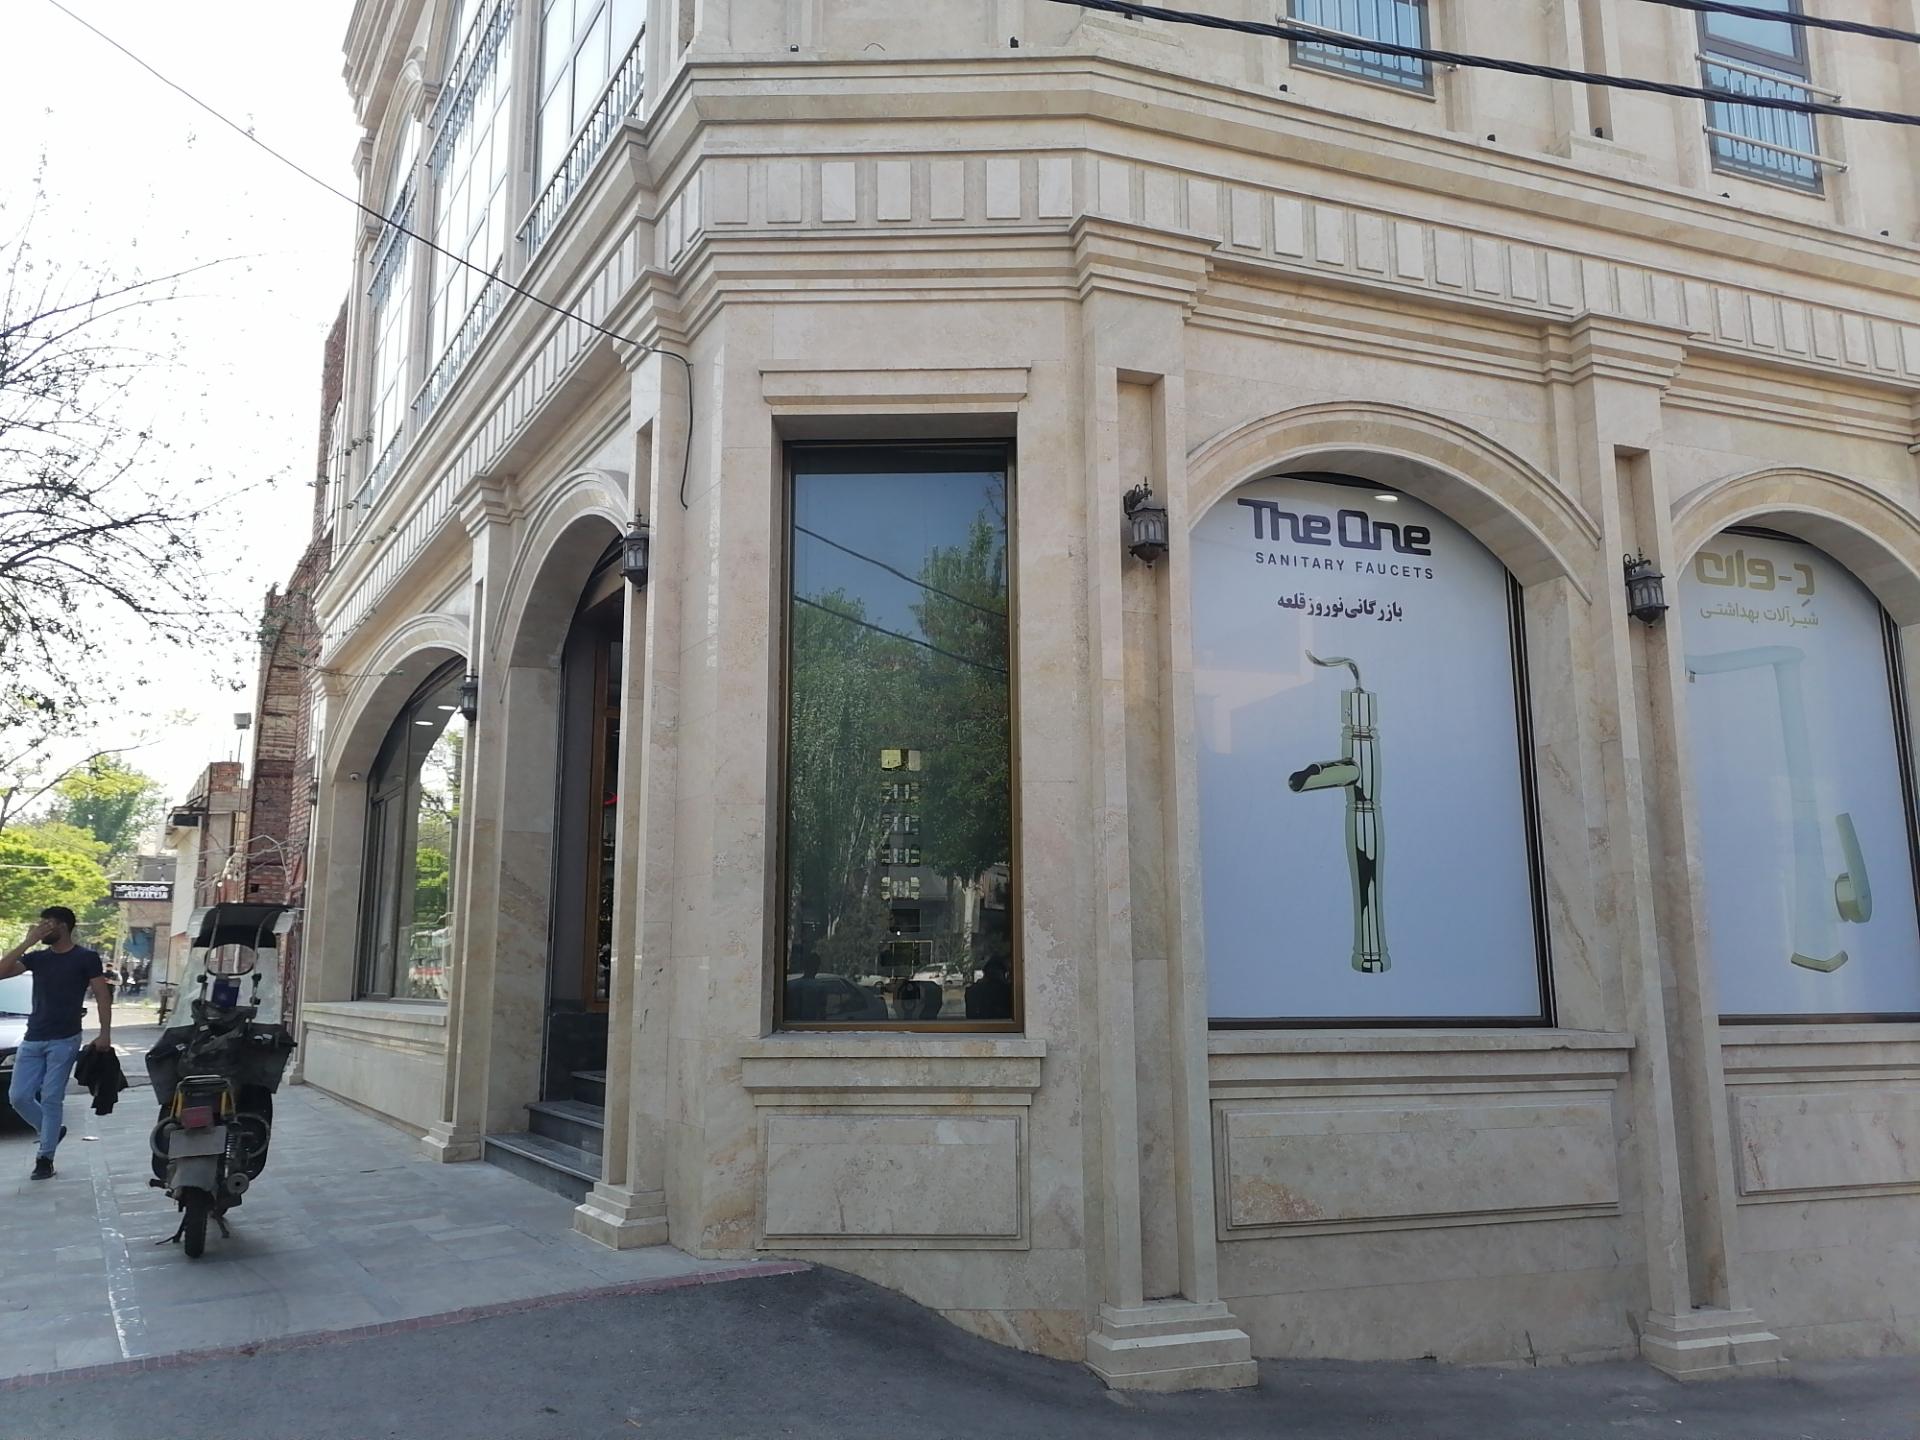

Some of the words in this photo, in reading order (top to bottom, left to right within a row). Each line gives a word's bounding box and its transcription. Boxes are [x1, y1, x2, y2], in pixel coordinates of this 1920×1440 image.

[1255, 552, 1345, 571] SANITARY
[1355, 561, 1433, 580] FAUCETS
[1344, 598, 1403, 622] بازرگانی
